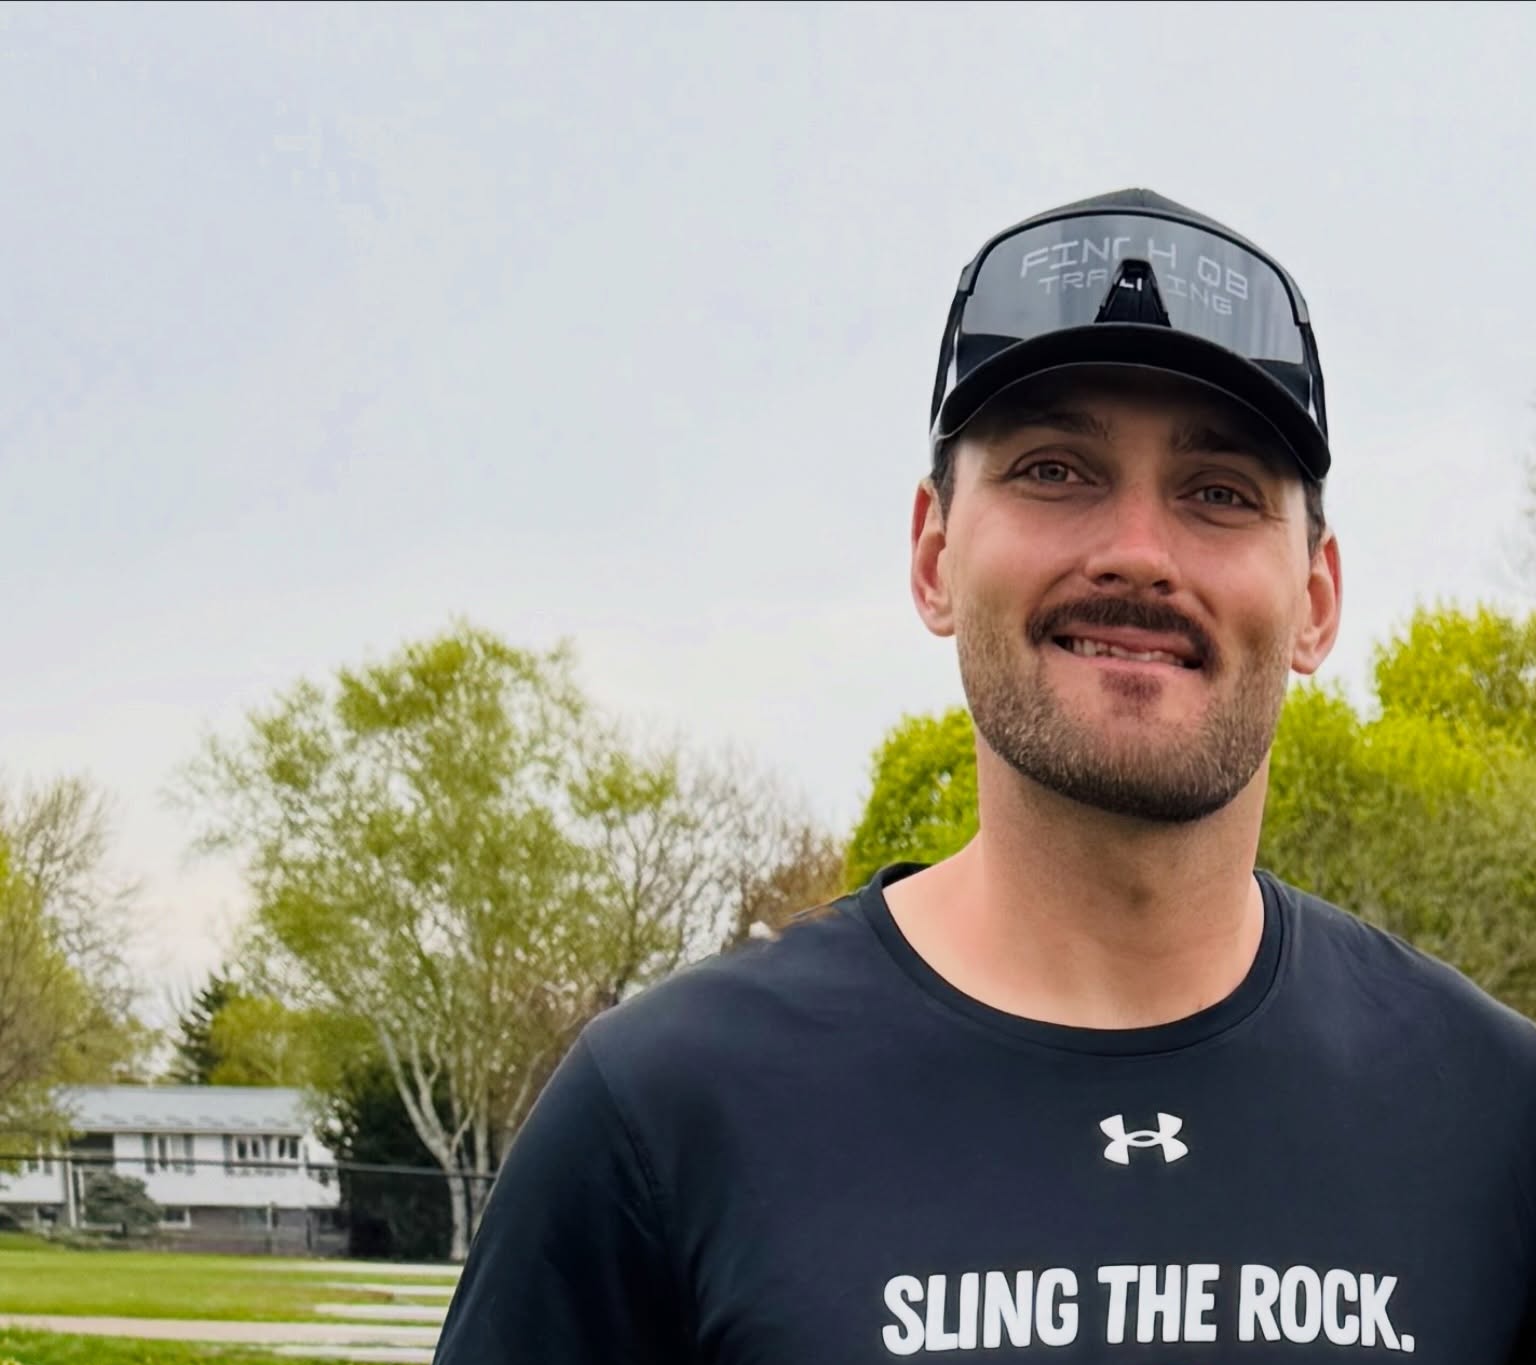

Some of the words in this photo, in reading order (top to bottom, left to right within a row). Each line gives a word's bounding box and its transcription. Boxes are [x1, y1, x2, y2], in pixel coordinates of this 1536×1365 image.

[1037, 267, 1233, 316] TRAING
[1197, 255, 1249, 301] QB
[882, 1267, 1079, 1355] SLING
[1097, 1263, 1220, 1344] THE
[1238, 1263, 1415, 1353] ROCK.
